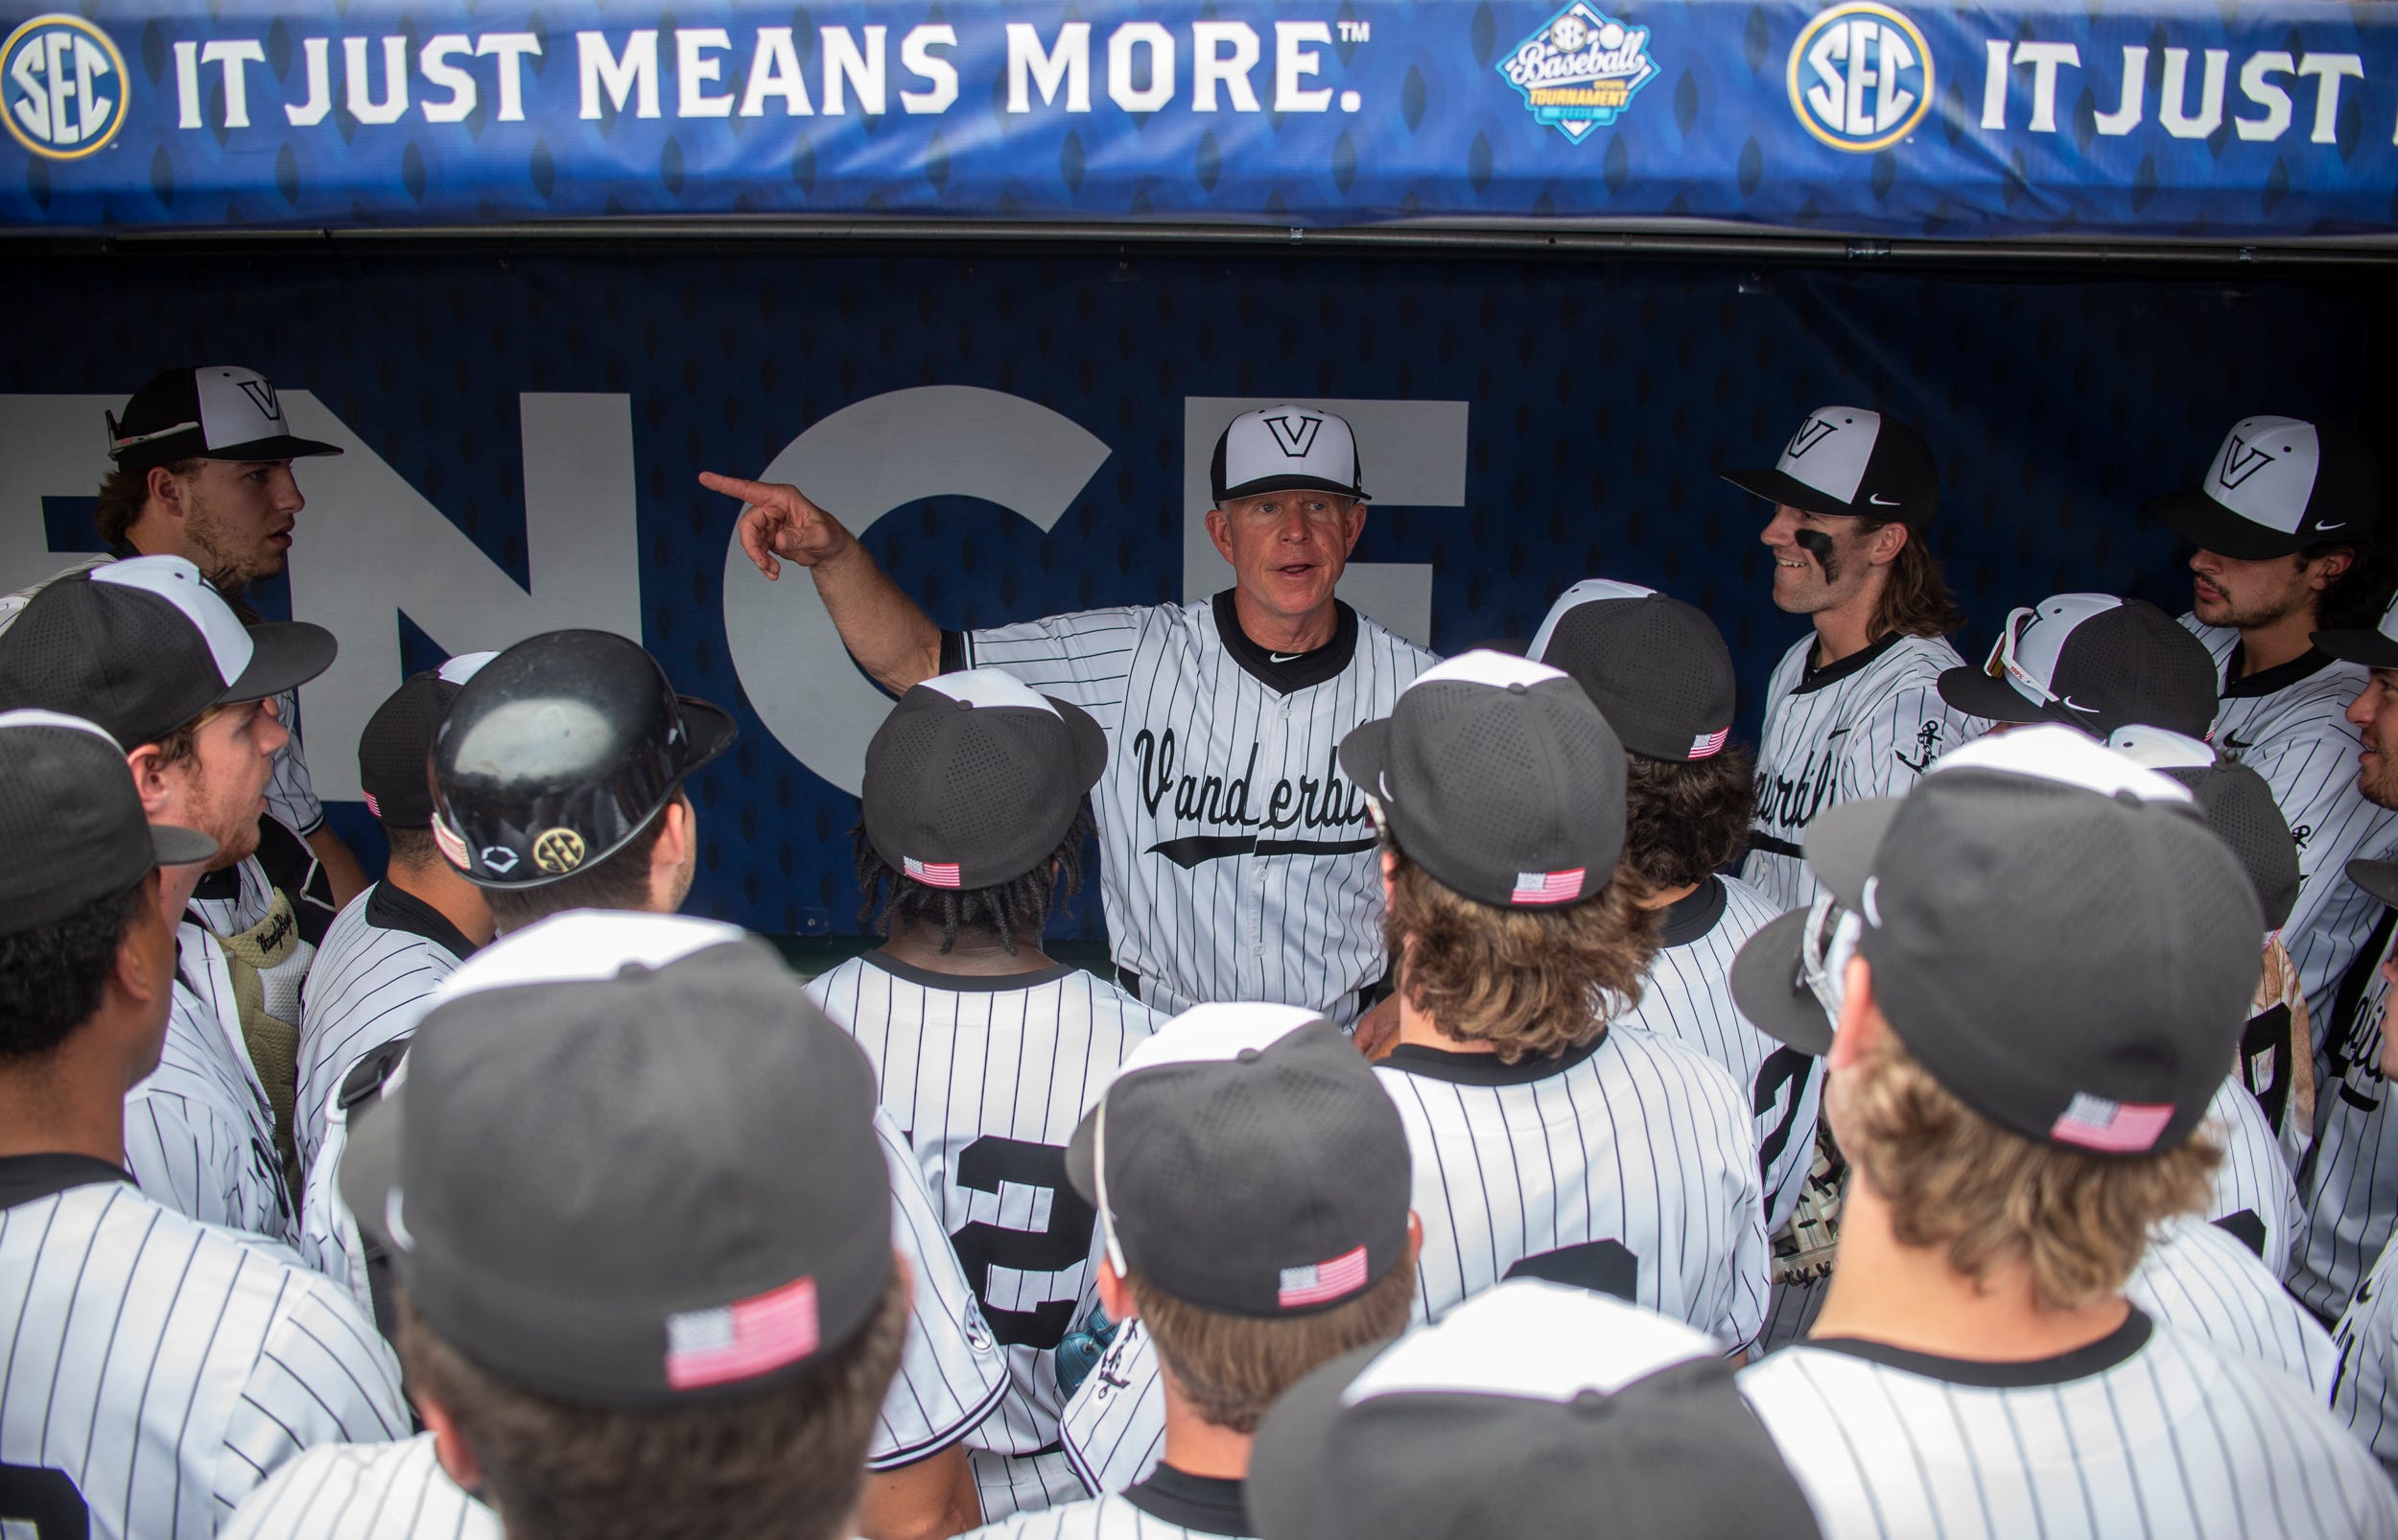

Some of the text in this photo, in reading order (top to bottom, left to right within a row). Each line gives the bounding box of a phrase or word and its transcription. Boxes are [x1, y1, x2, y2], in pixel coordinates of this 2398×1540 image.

[10, 32, 113, 144] SEC
[174, 39, 266, 129] IT
[285, 33, 543, 127] JUST
[576, 23, 959, 120] MEANS
[1510, 29, 1647, 85] Baseball
[1530, 88, 1628, 105] TOURNAMENT
[1806, 20, 1916, 136] SEC
[1981, 39, 2081, 133] IT
[2093, 45, 2365, 144] JUST
[1133, 726, 1372, 831] Vanderbi
